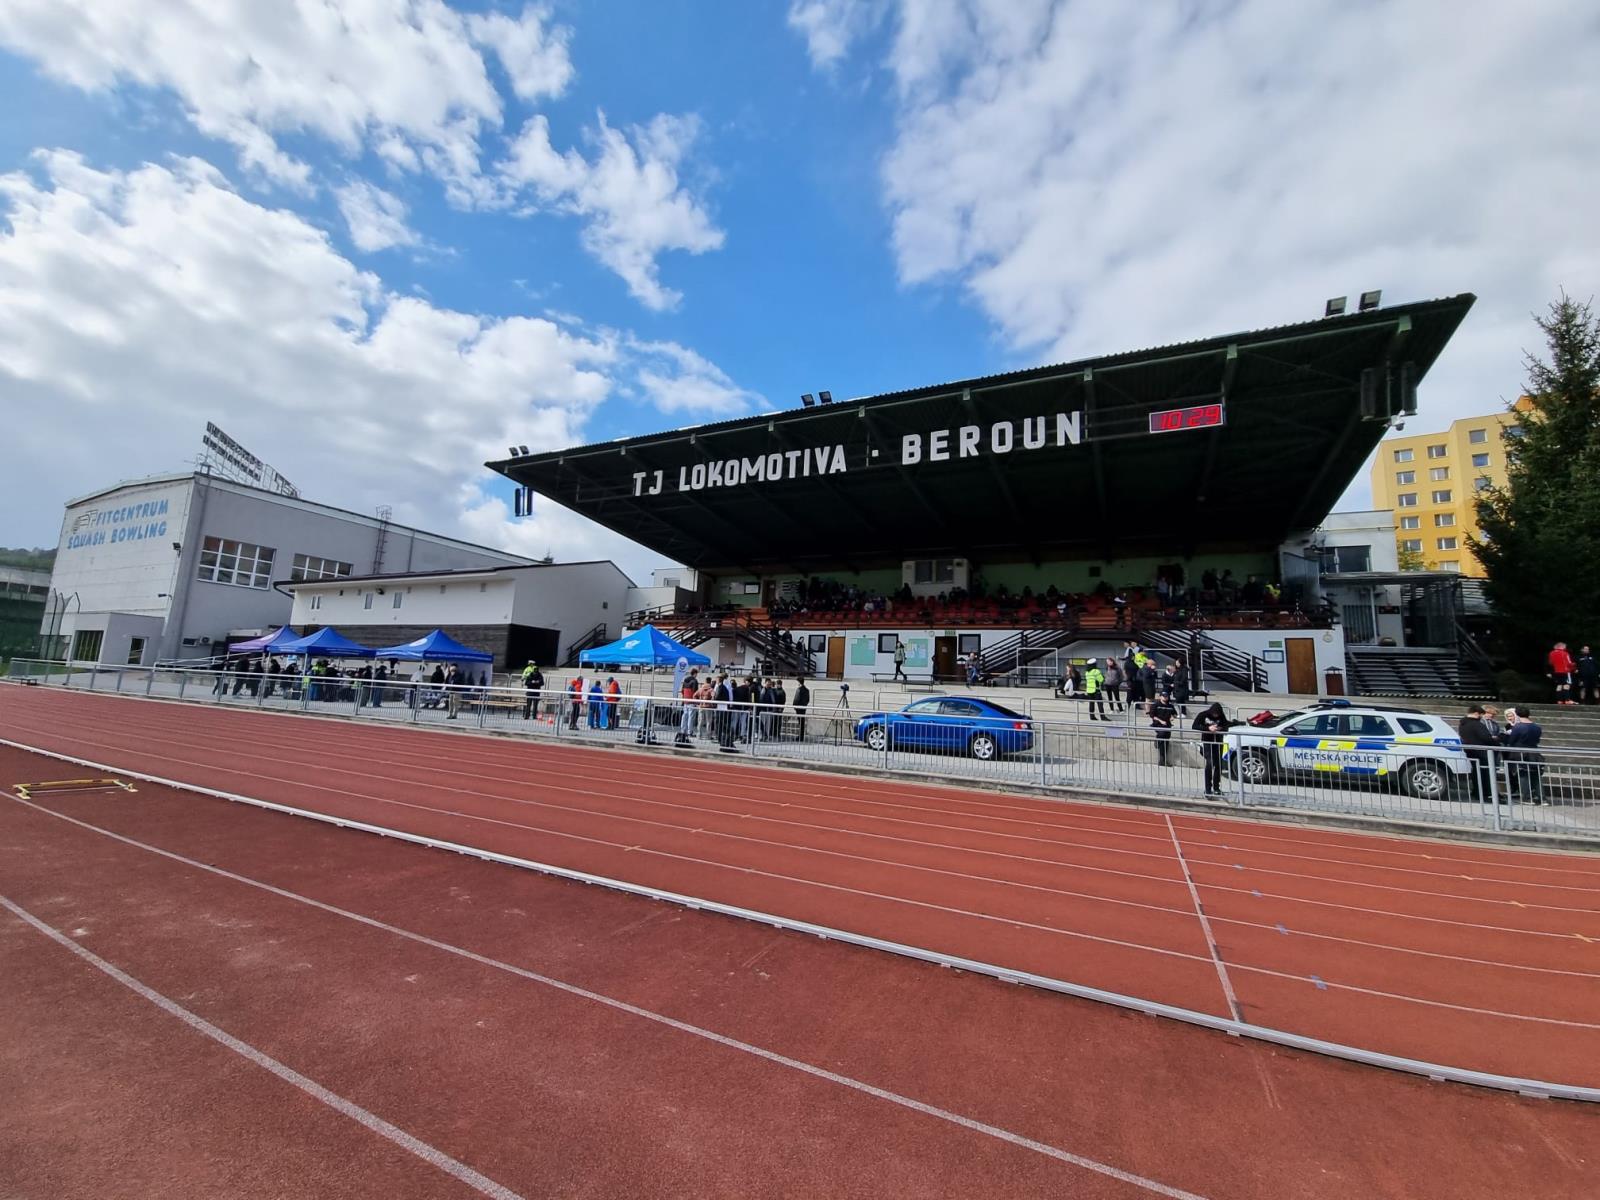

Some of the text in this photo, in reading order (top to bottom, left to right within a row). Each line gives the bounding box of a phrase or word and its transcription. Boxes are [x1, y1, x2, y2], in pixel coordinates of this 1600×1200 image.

[632, 411, 1081, 497] TJ LOKOMOTIVA BEROUN
[96, 499, 169, 526] FITCENTRUM
[67, 530, 106, 549] SQUASH
[110, 521, 167, 543] BOWLING
[1343, 753, 1383, 764] POLICIE
